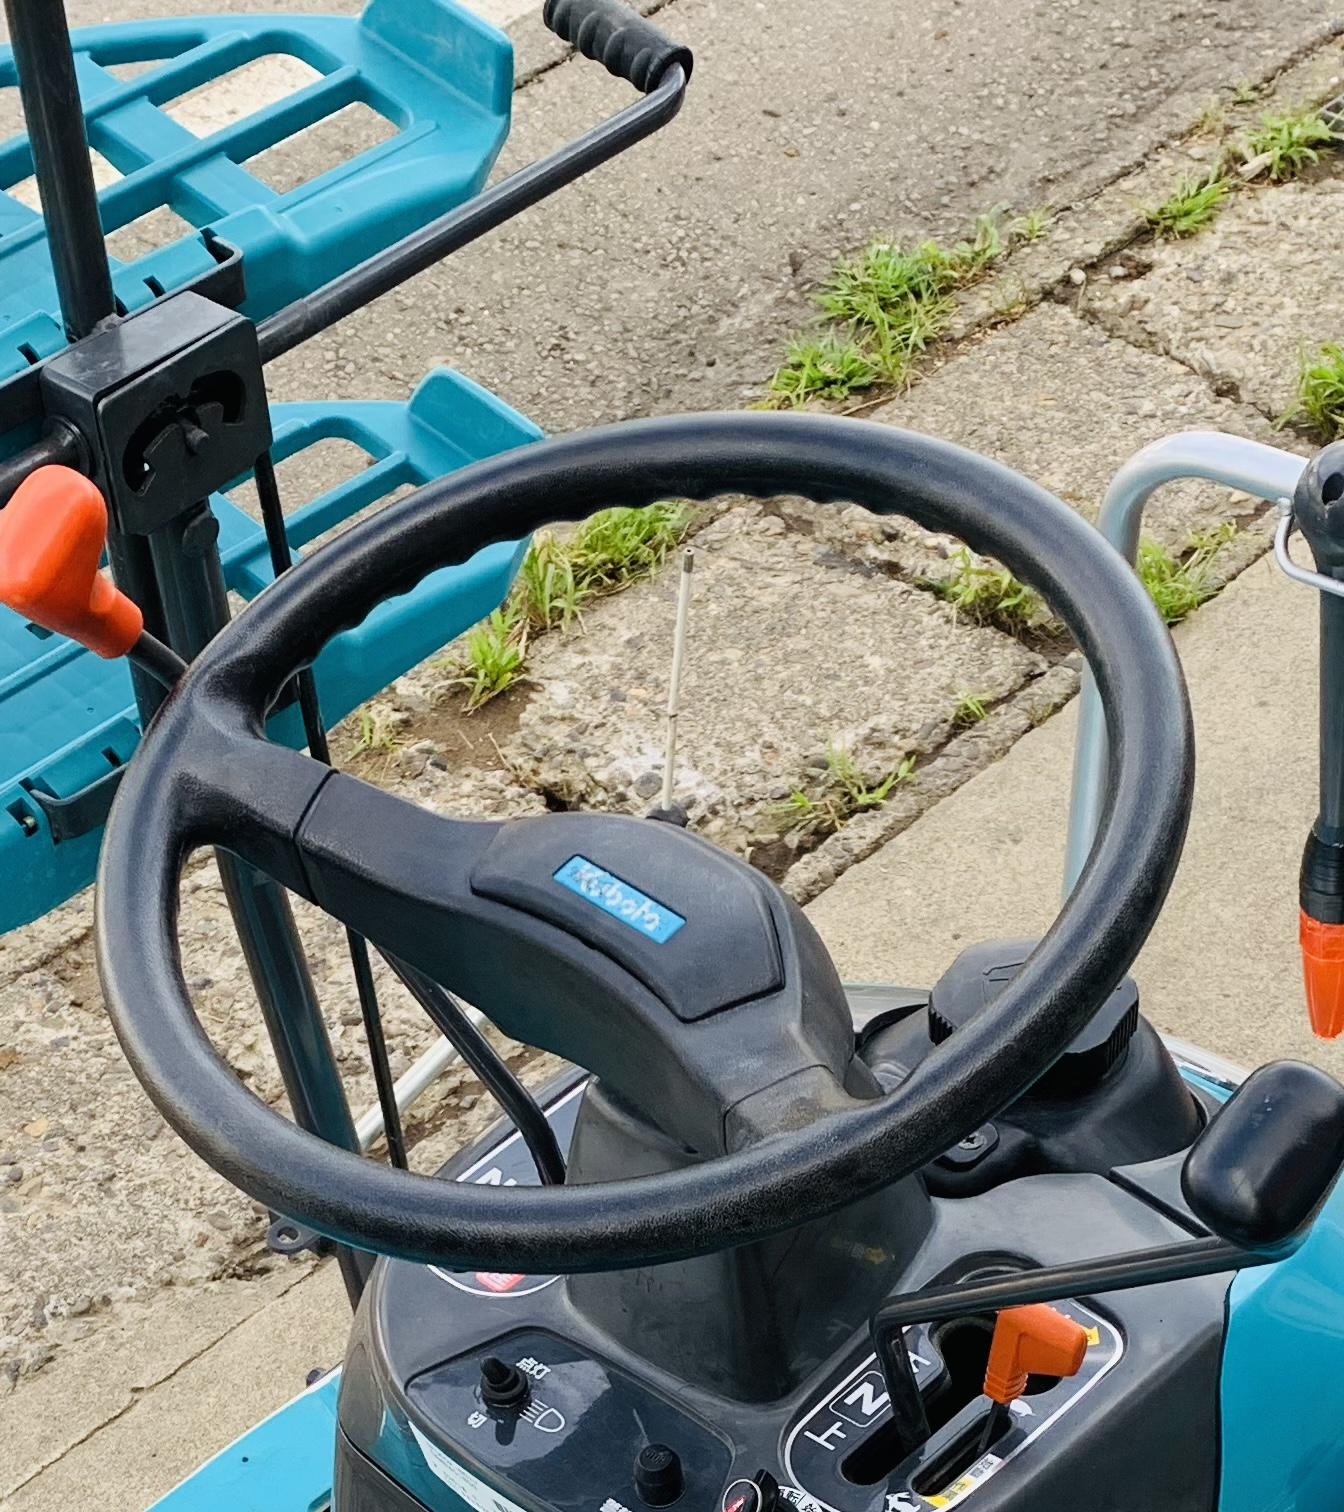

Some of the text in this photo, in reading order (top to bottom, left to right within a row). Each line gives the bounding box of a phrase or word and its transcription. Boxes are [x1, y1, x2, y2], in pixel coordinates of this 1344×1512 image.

[517, 1356, 552, 1380] 点灯
[843, 1381, 891, 1417] N
[467, 1413, 486, 1431] 切
